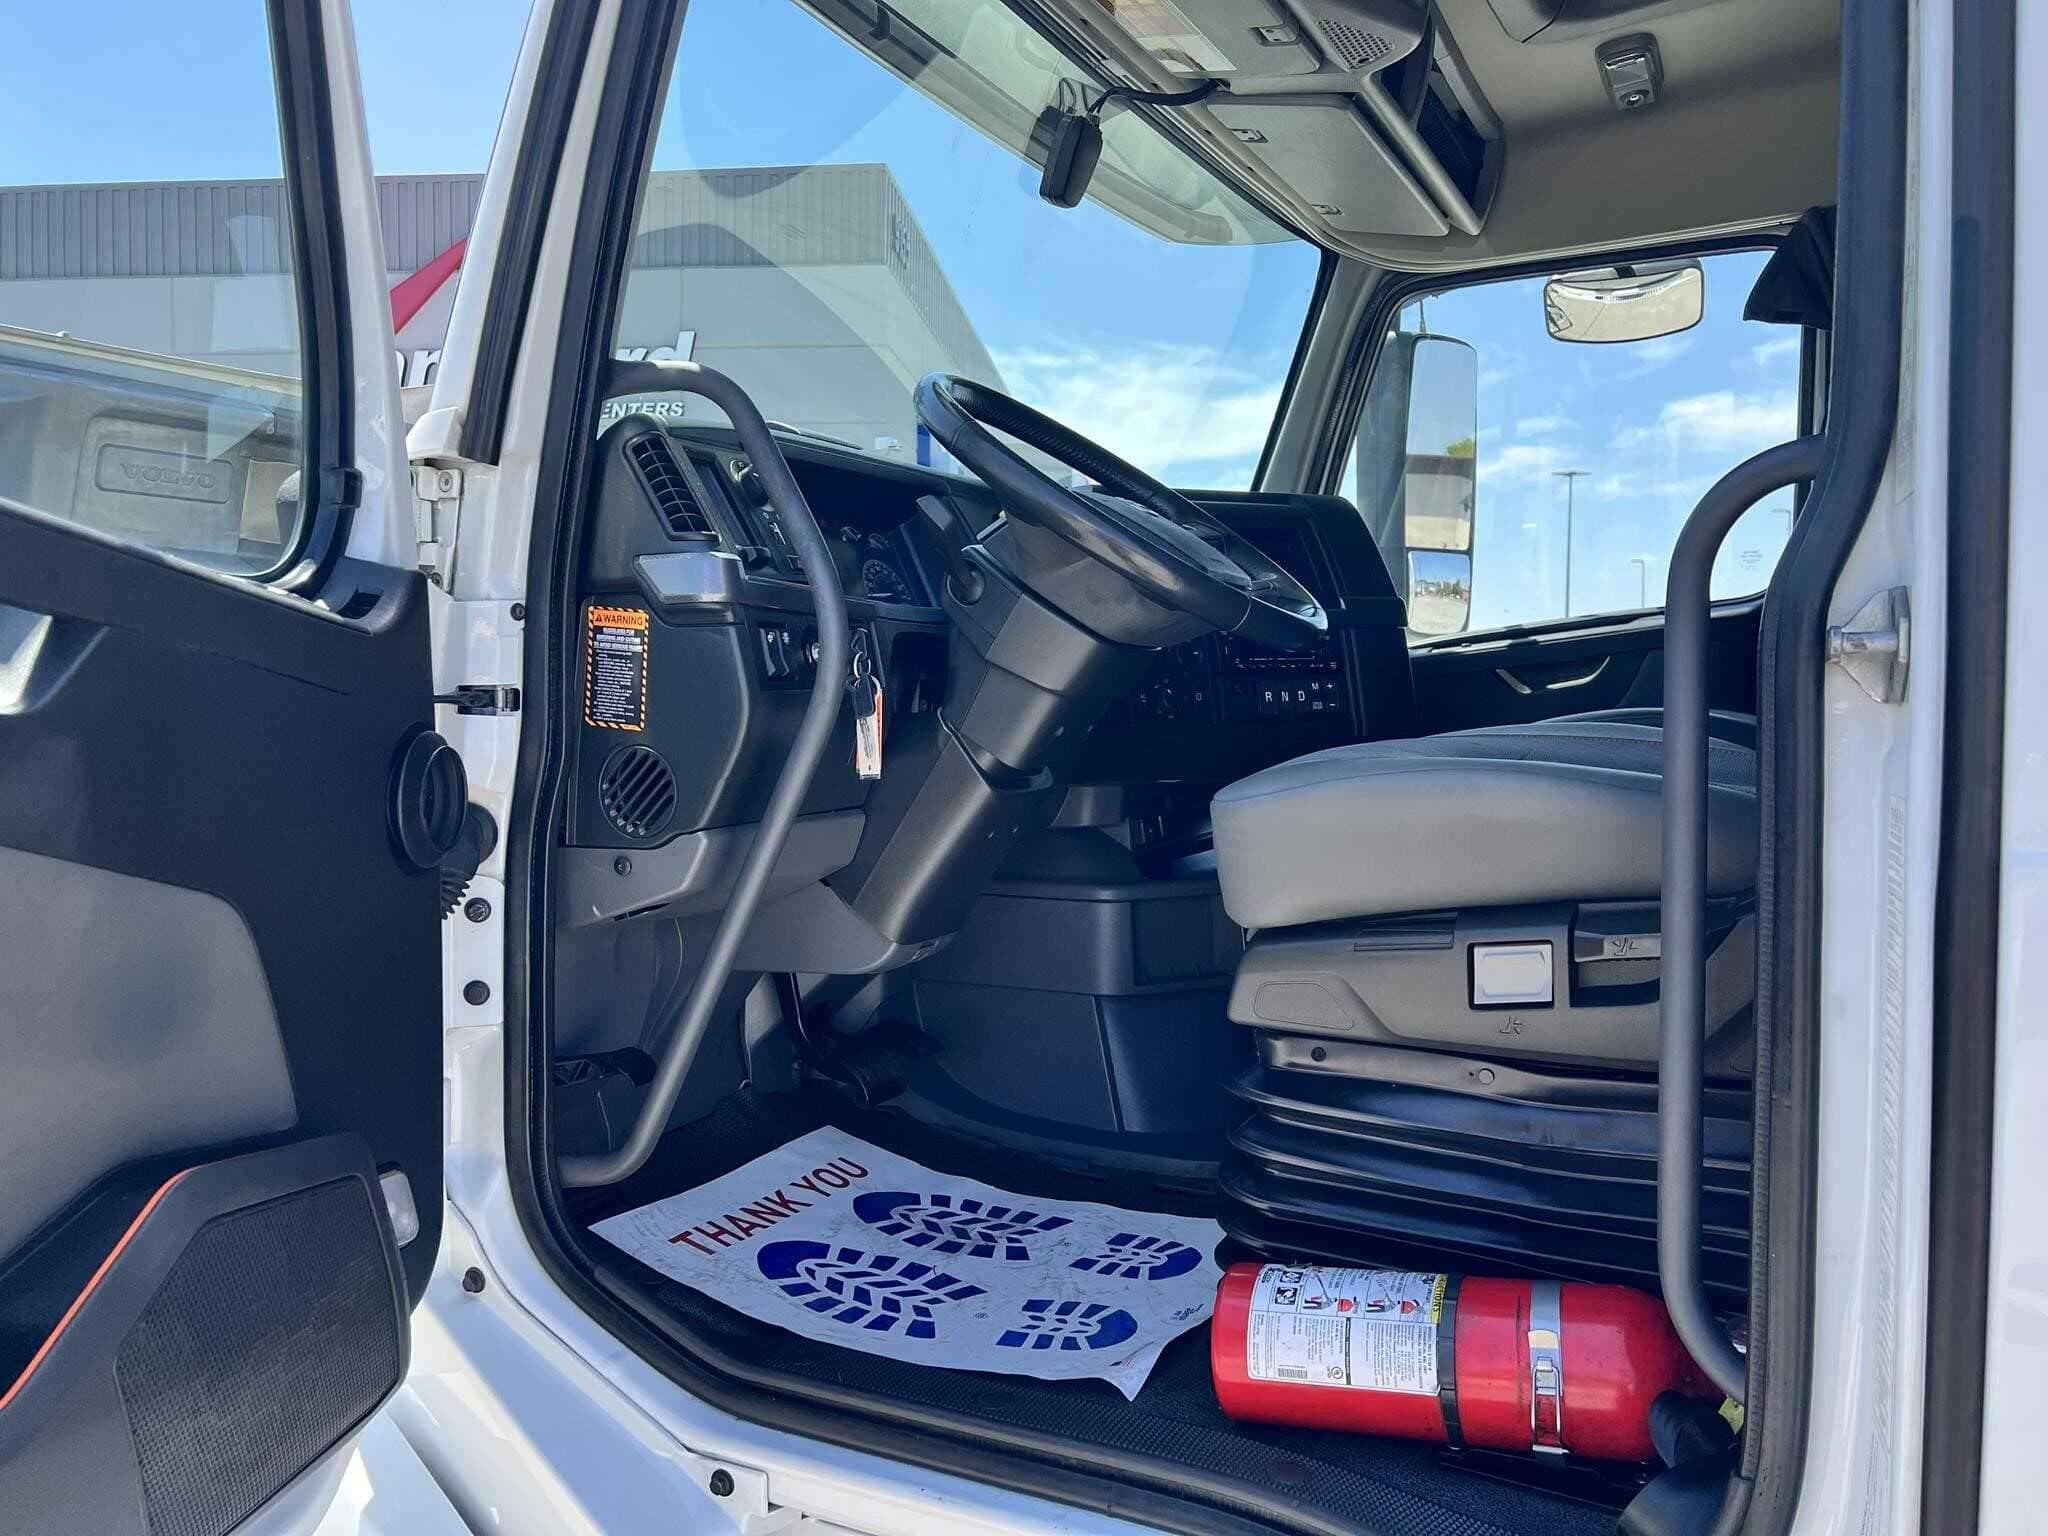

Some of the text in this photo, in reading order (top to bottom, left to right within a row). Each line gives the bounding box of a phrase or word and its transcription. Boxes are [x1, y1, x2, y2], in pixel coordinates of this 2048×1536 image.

[120, 463, 215, 488] VOLVO
[604, 613, 643, 626] WARNING
[1265, 690, 1305, 702] R N D
[668, 1157, 869, 1255] THANK YOU
